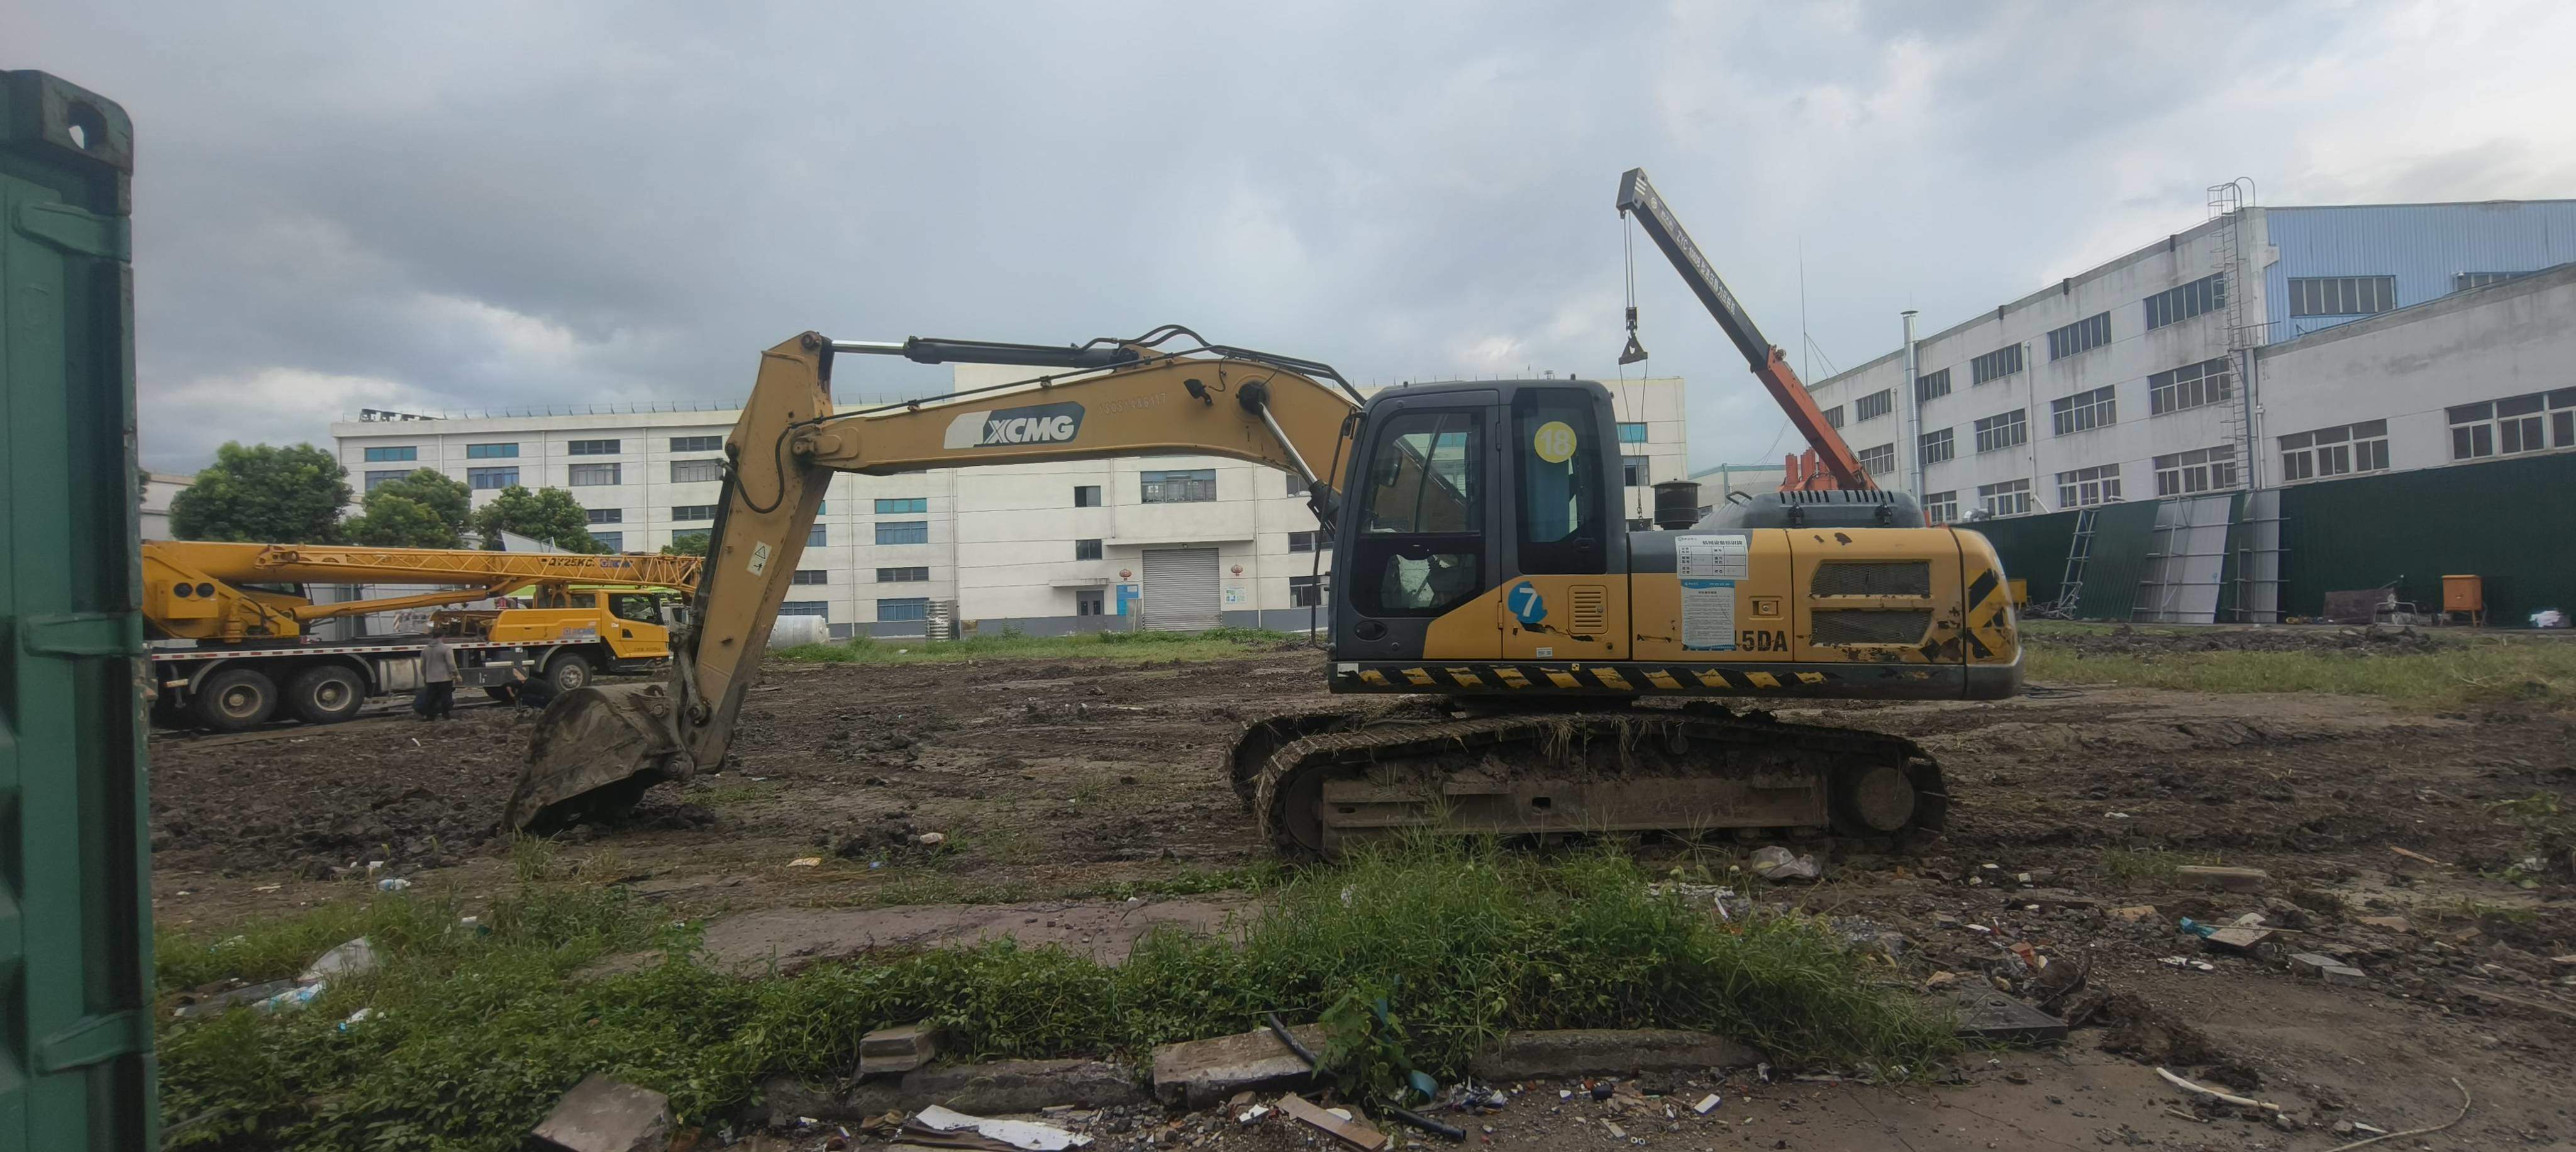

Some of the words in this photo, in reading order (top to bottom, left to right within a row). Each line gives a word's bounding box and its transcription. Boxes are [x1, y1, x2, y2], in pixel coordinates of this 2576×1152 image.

[983, 415, 1075, 444] XCMG
[1540, 428, 1571, 456] 18
[1519, 587, 1539, 617] 7
[1734, 629, 1788, 652] 5DA
